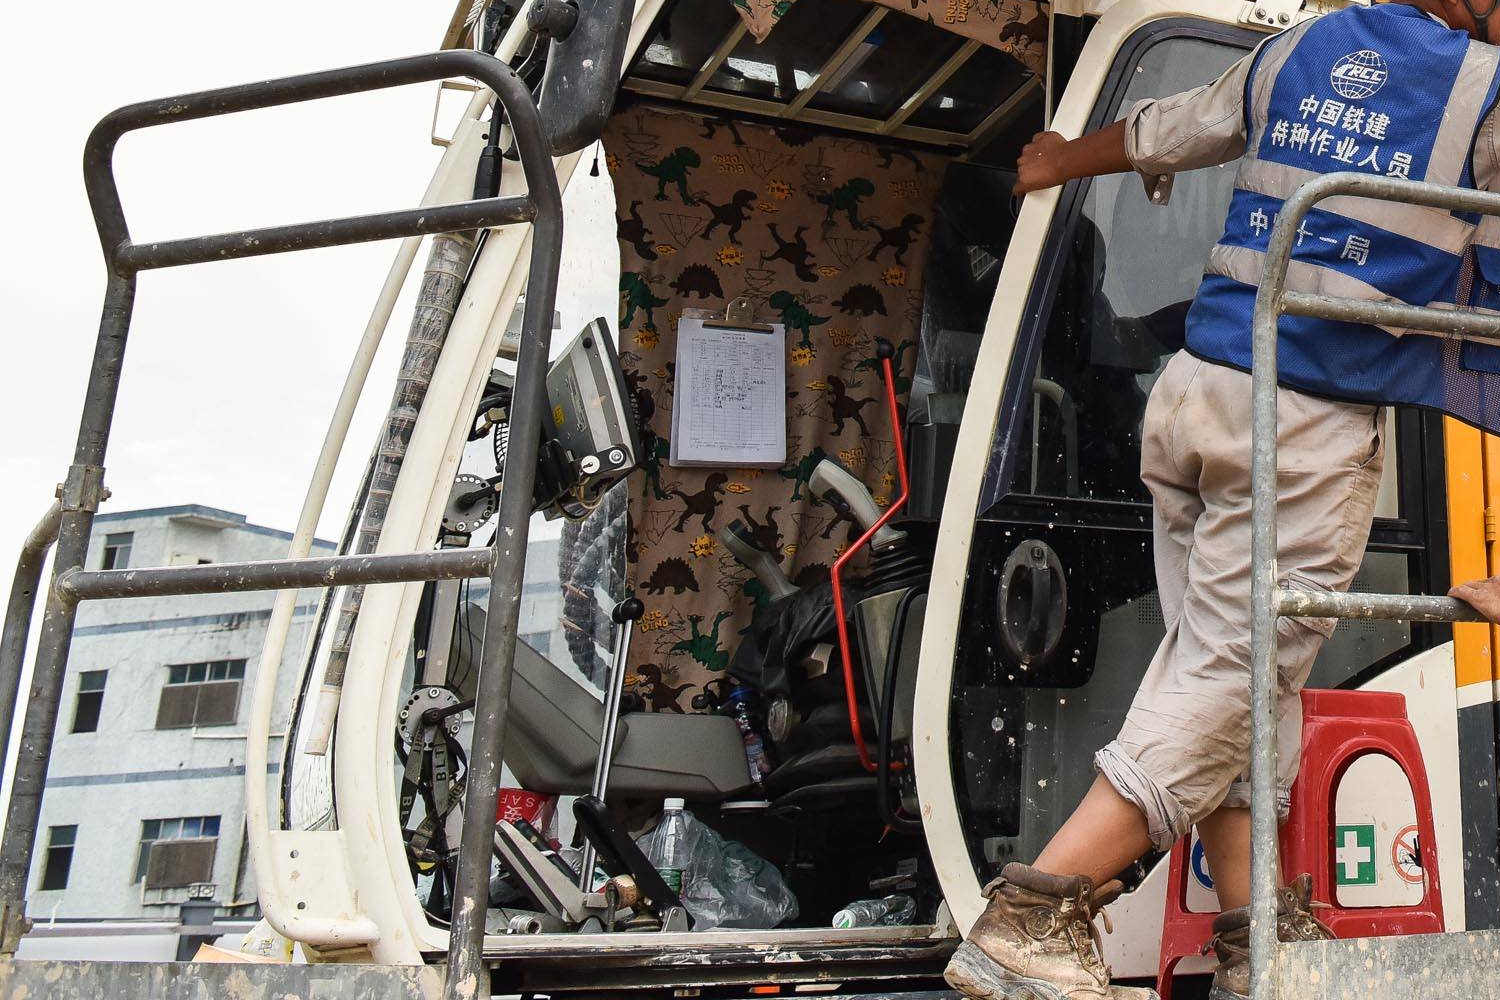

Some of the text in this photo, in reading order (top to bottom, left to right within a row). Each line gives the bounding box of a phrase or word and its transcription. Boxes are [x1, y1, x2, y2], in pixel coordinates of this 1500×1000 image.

[1298, 94, 1391, 141] 中国铁建
[1271, 119, 1413, 181] 特种作业人员
[1250, 207, 1371, 266] 中十一局
[435, 749, 448, 782] BLT
